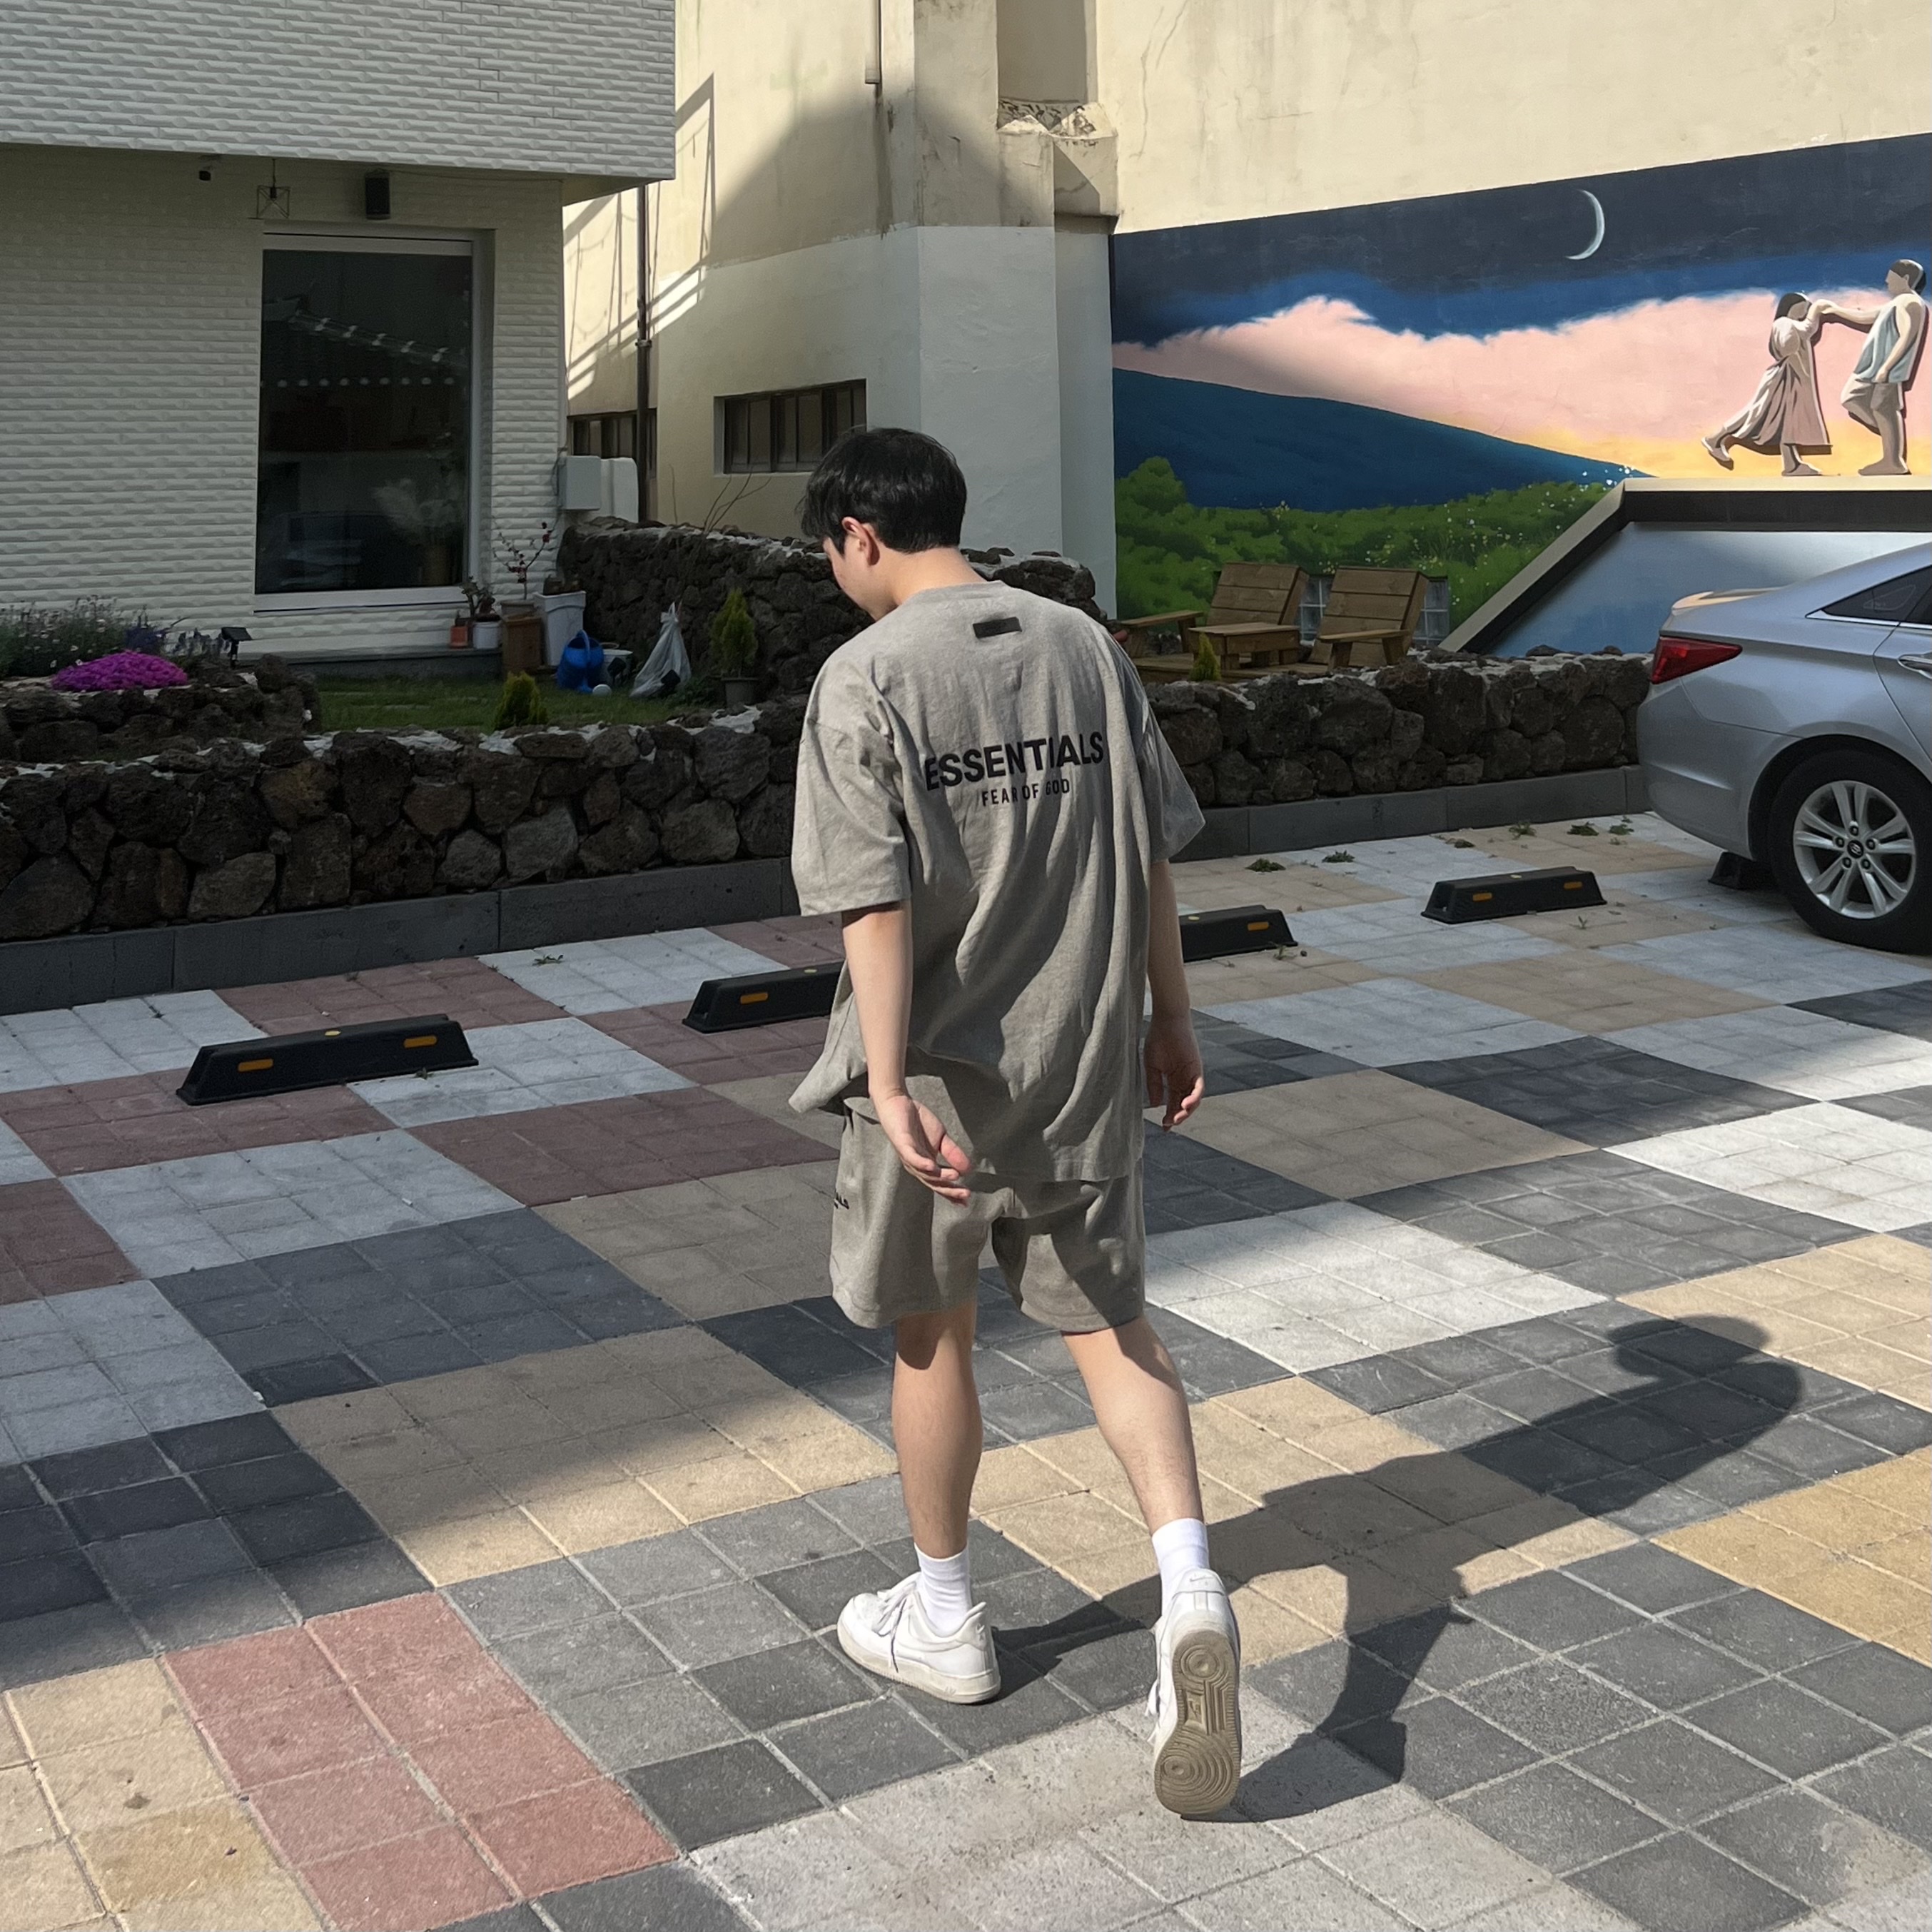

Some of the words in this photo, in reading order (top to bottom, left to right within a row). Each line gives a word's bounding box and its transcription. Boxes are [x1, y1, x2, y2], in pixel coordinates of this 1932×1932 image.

[924, 732, 1104, 791] ESSENTIALS
[981, 787, 1018, 806] FEAR
[1022, 783, 1039, 800] OF
[1046, 779, 1070, 795] GOD
